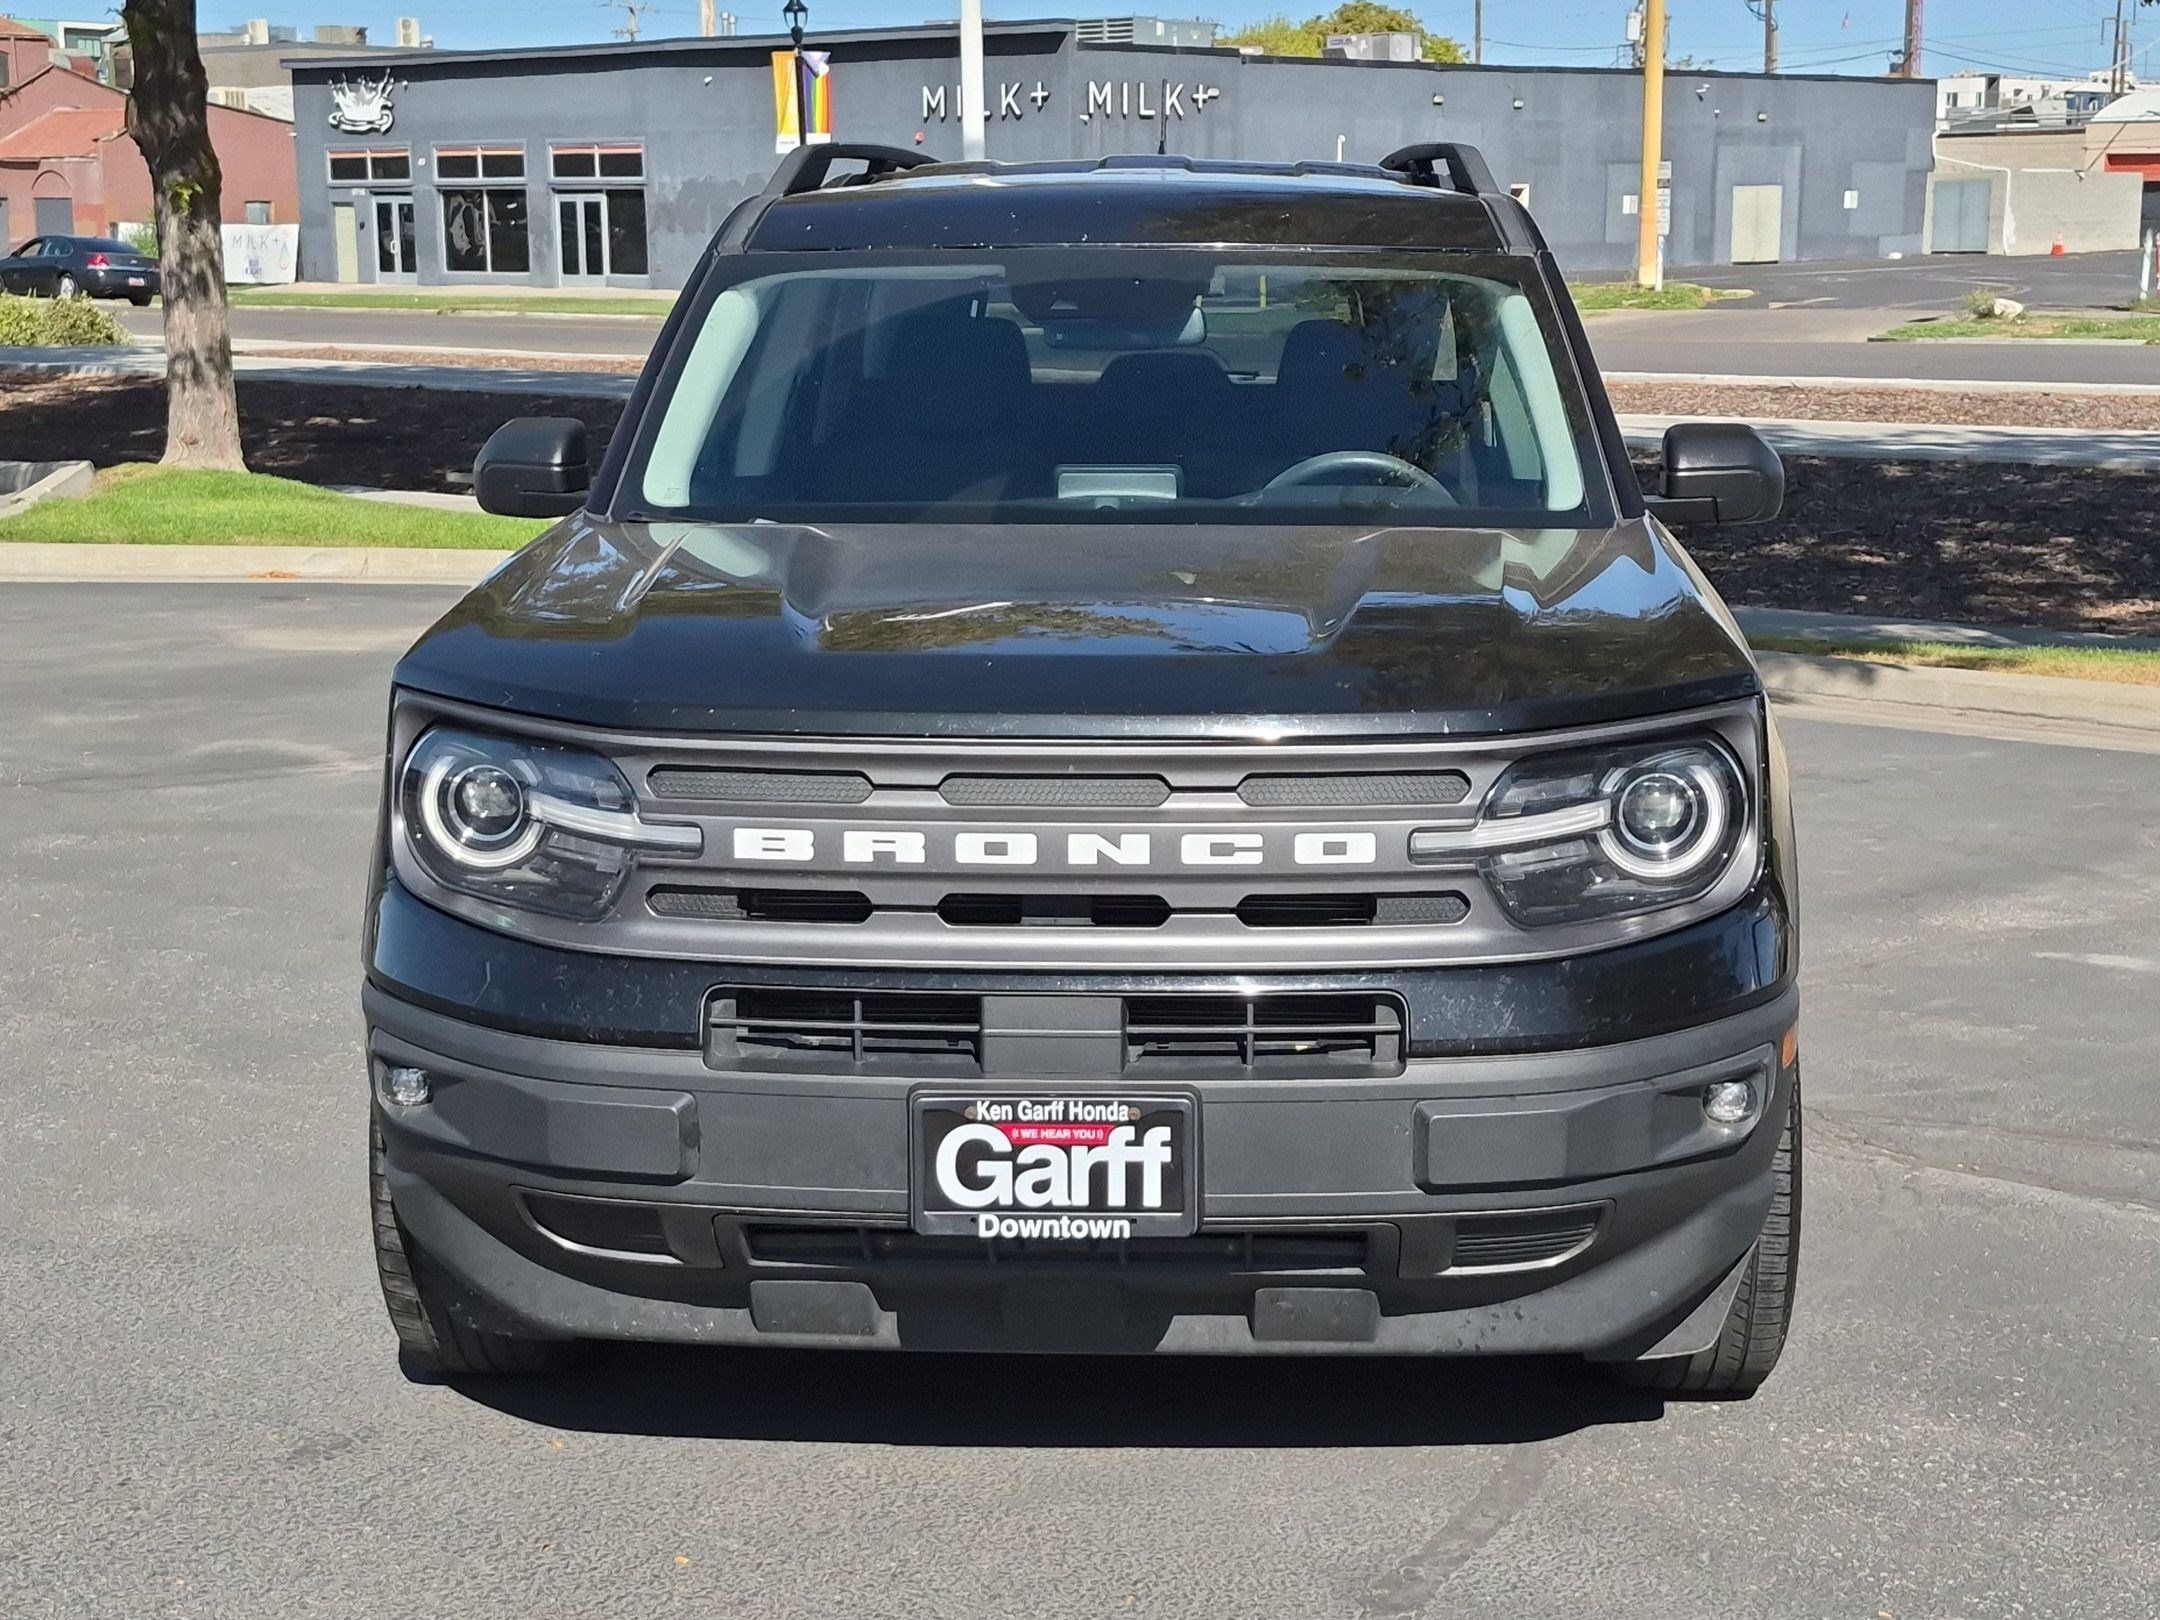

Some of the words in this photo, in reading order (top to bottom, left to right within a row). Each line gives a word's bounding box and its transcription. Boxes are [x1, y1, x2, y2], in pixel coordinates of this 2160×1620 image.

[1087, 80, 1208, 118] MILK+
[733, 828, 1376, 865] BRONCO
[976, 1100, 1012, 1121] Ken
[1017, 1100, 1064, 1121] Garff
[1068, 1100, 1130, 1122] Honda
[1021, 1128, 1038, 1139] WE
[1041, 1128, 1071, 1139] HEAR
[1072, 1128, 1096, 1139] YOU
[935, 1123, 1171, 1208] Garff
[978, 1213, 1131, 1239] Downtown
